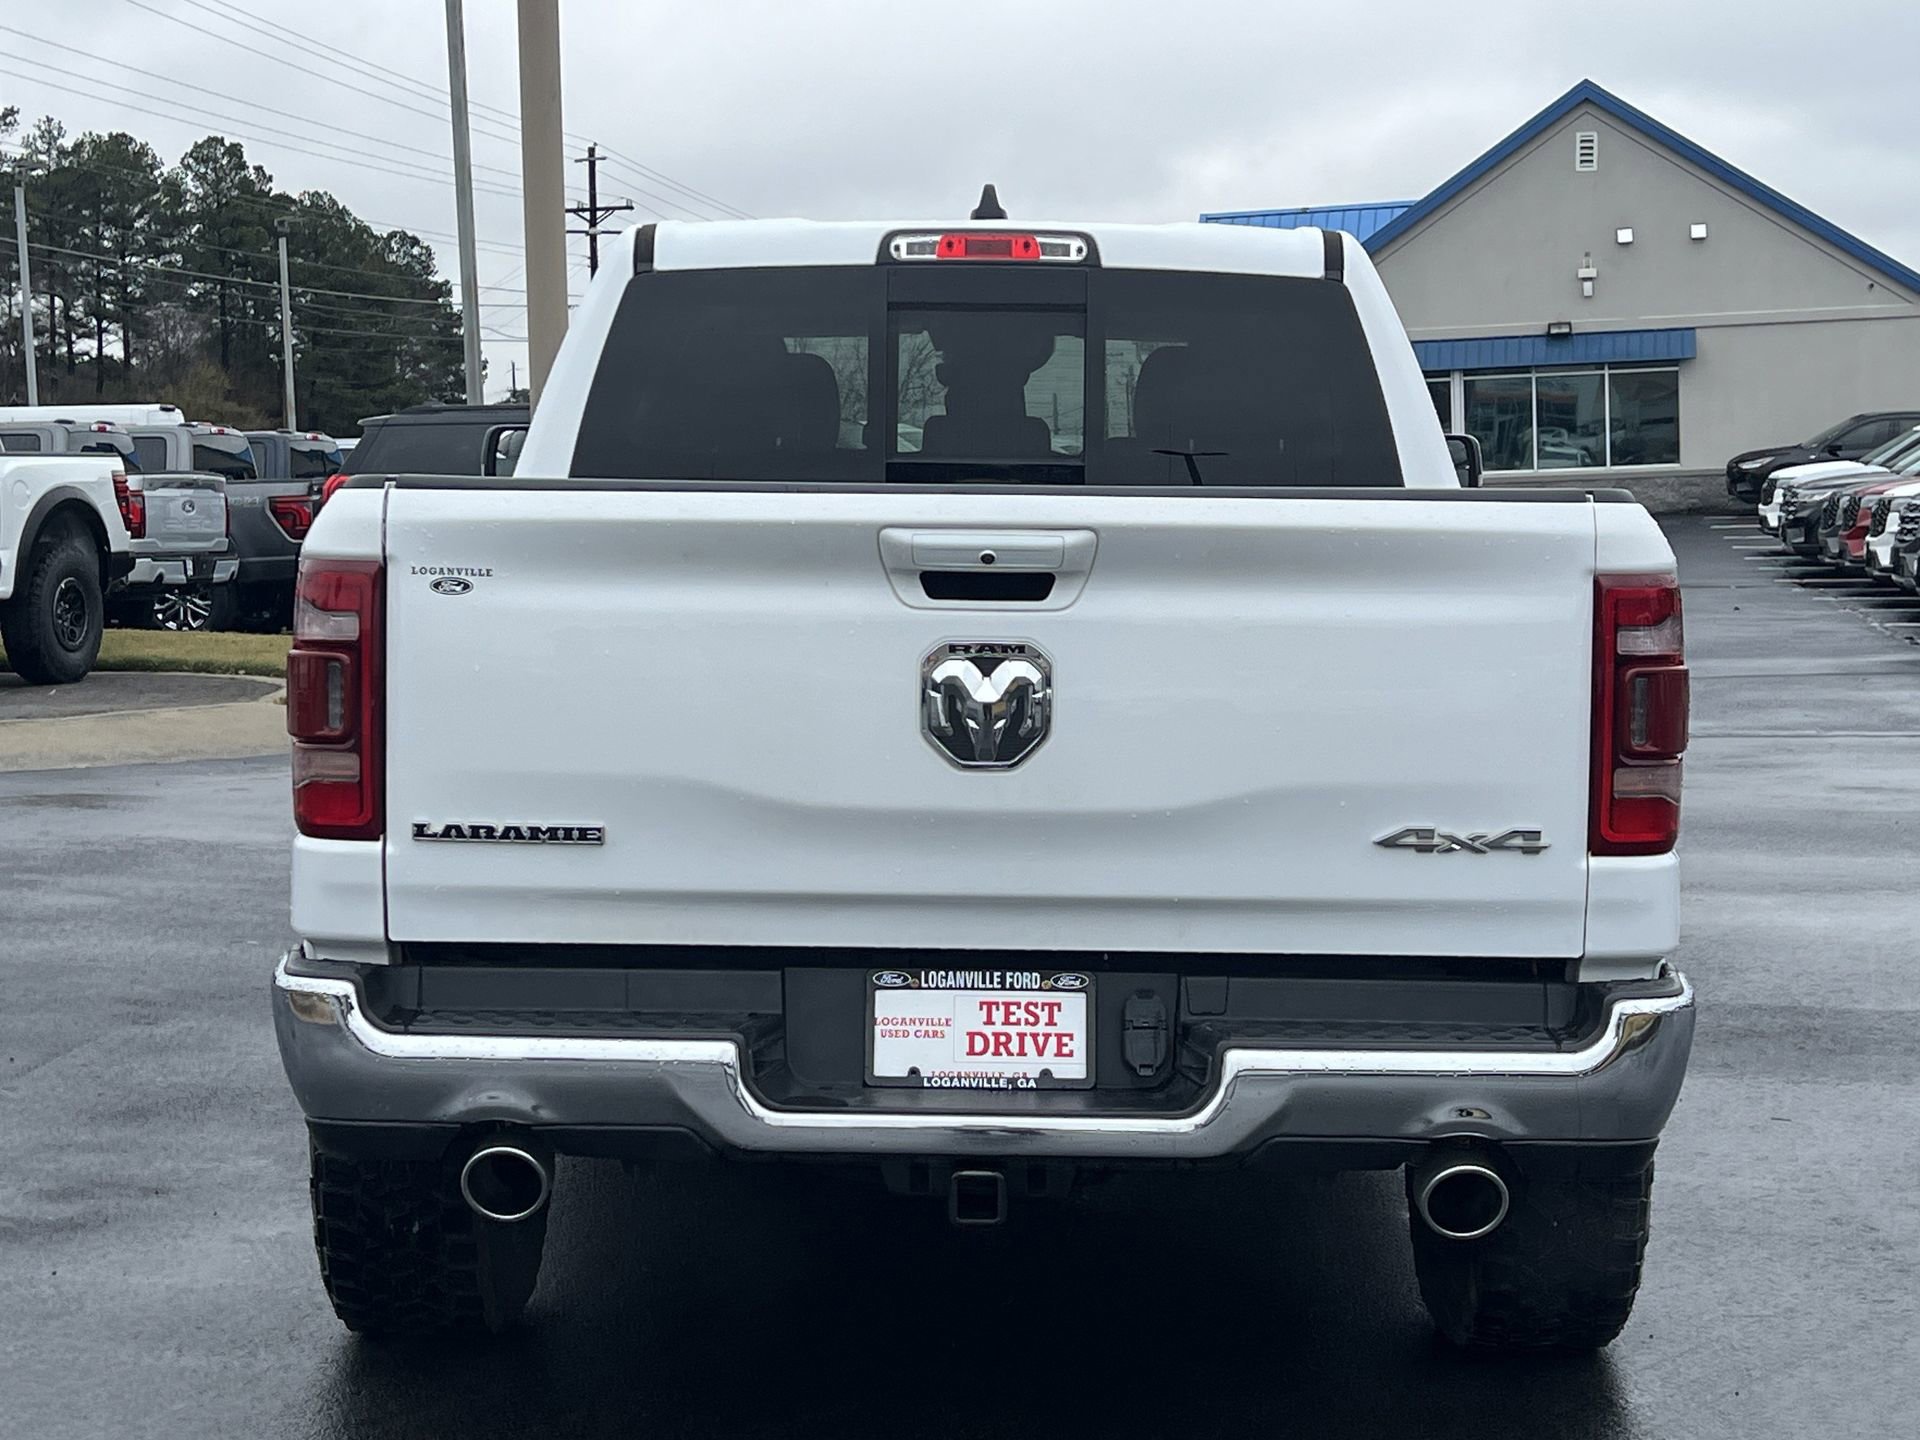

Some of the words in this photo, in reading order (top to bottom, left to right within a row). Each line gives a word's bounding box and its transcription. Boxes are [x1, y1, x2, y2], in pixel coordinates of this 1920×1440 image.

[411, 566, 494, 577] LOGANVILLE
[948, 644, 1026, 654] RAM
[412, 822, 606, 846] LARAMIE
[879, 973, 904, 984] Ford
[921, 970, 1002, 989] LOGANVILLE
[1005, 972, 1040, 990] FORD
[1057, 976, 1081, 987] Ford
[979, 1000, 1062, 1027] TEST
[874, 1017, 952, 1027] LOGANVILLE
[880, 1029, 910, 1039] USED
[913, 1029, 945, 1039] CARS
[965, 1031, 1074, 1058] DRIVE
[923, 1077, 1012, 1090] LOGANVILLE,
[1016, 1078, 1037, 1089] GA
